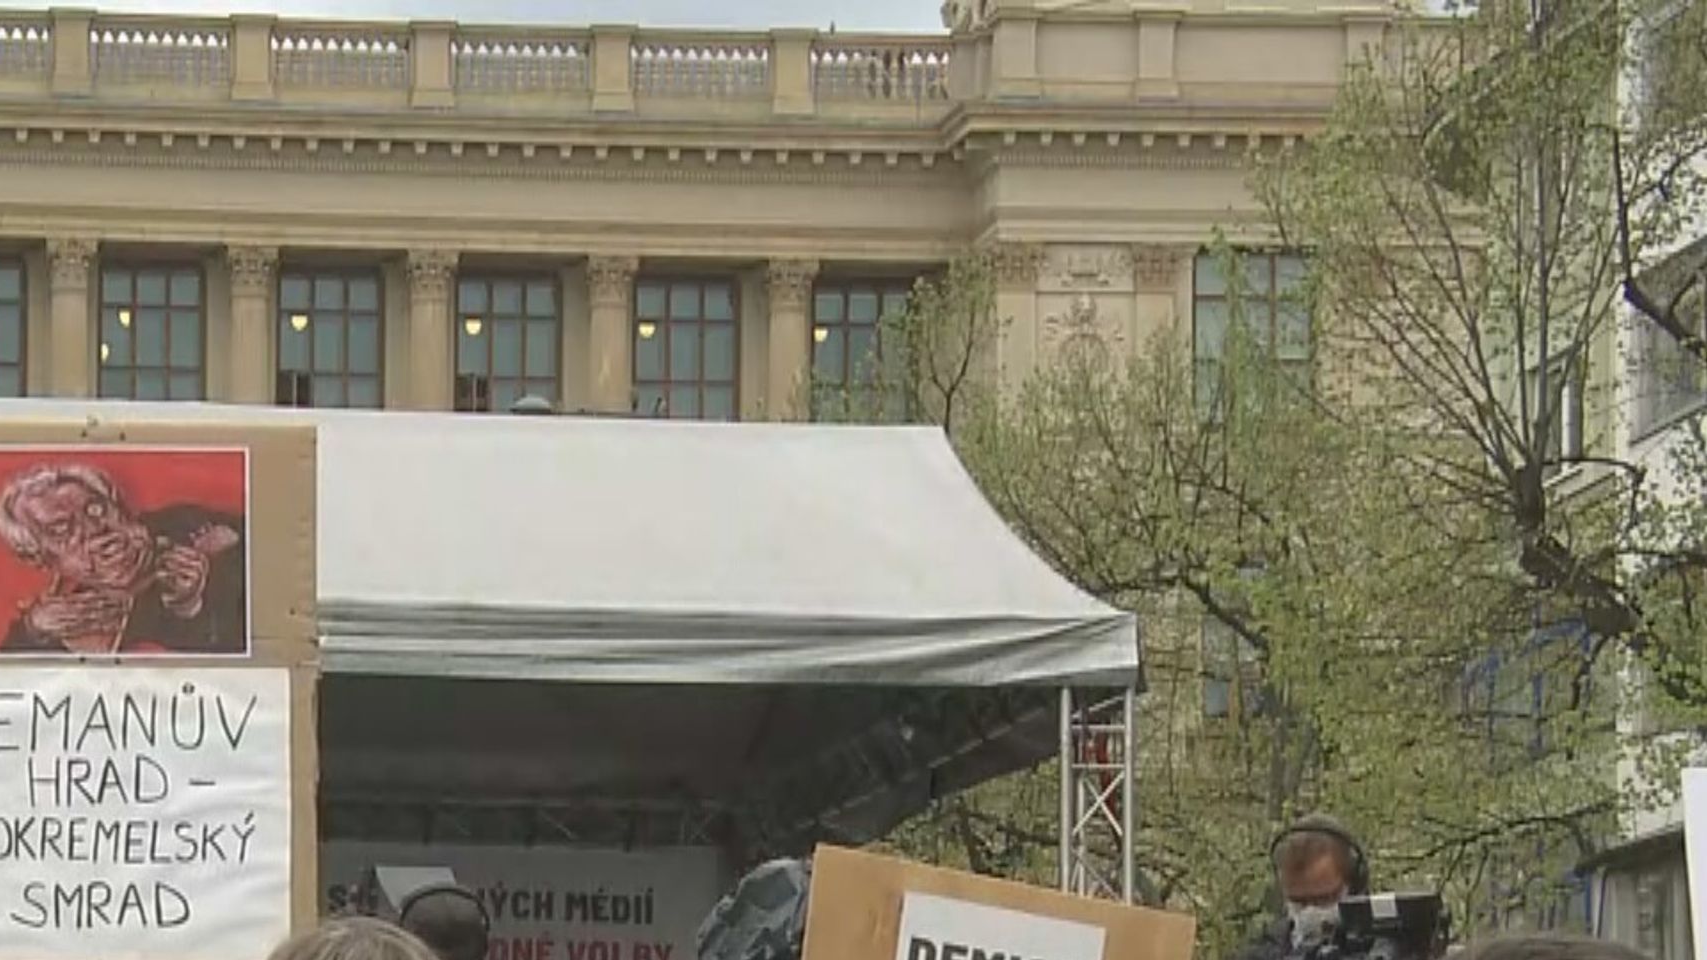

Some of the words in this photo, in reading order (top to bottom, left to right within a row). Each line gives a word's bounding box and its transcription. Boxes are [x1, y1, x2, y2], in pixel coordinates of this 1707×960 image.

[28, 754, 169, 808] HRAD
[11, 880, 192, 931] SMRAD
[564, 884, 654, 926] MÉDIÍ
